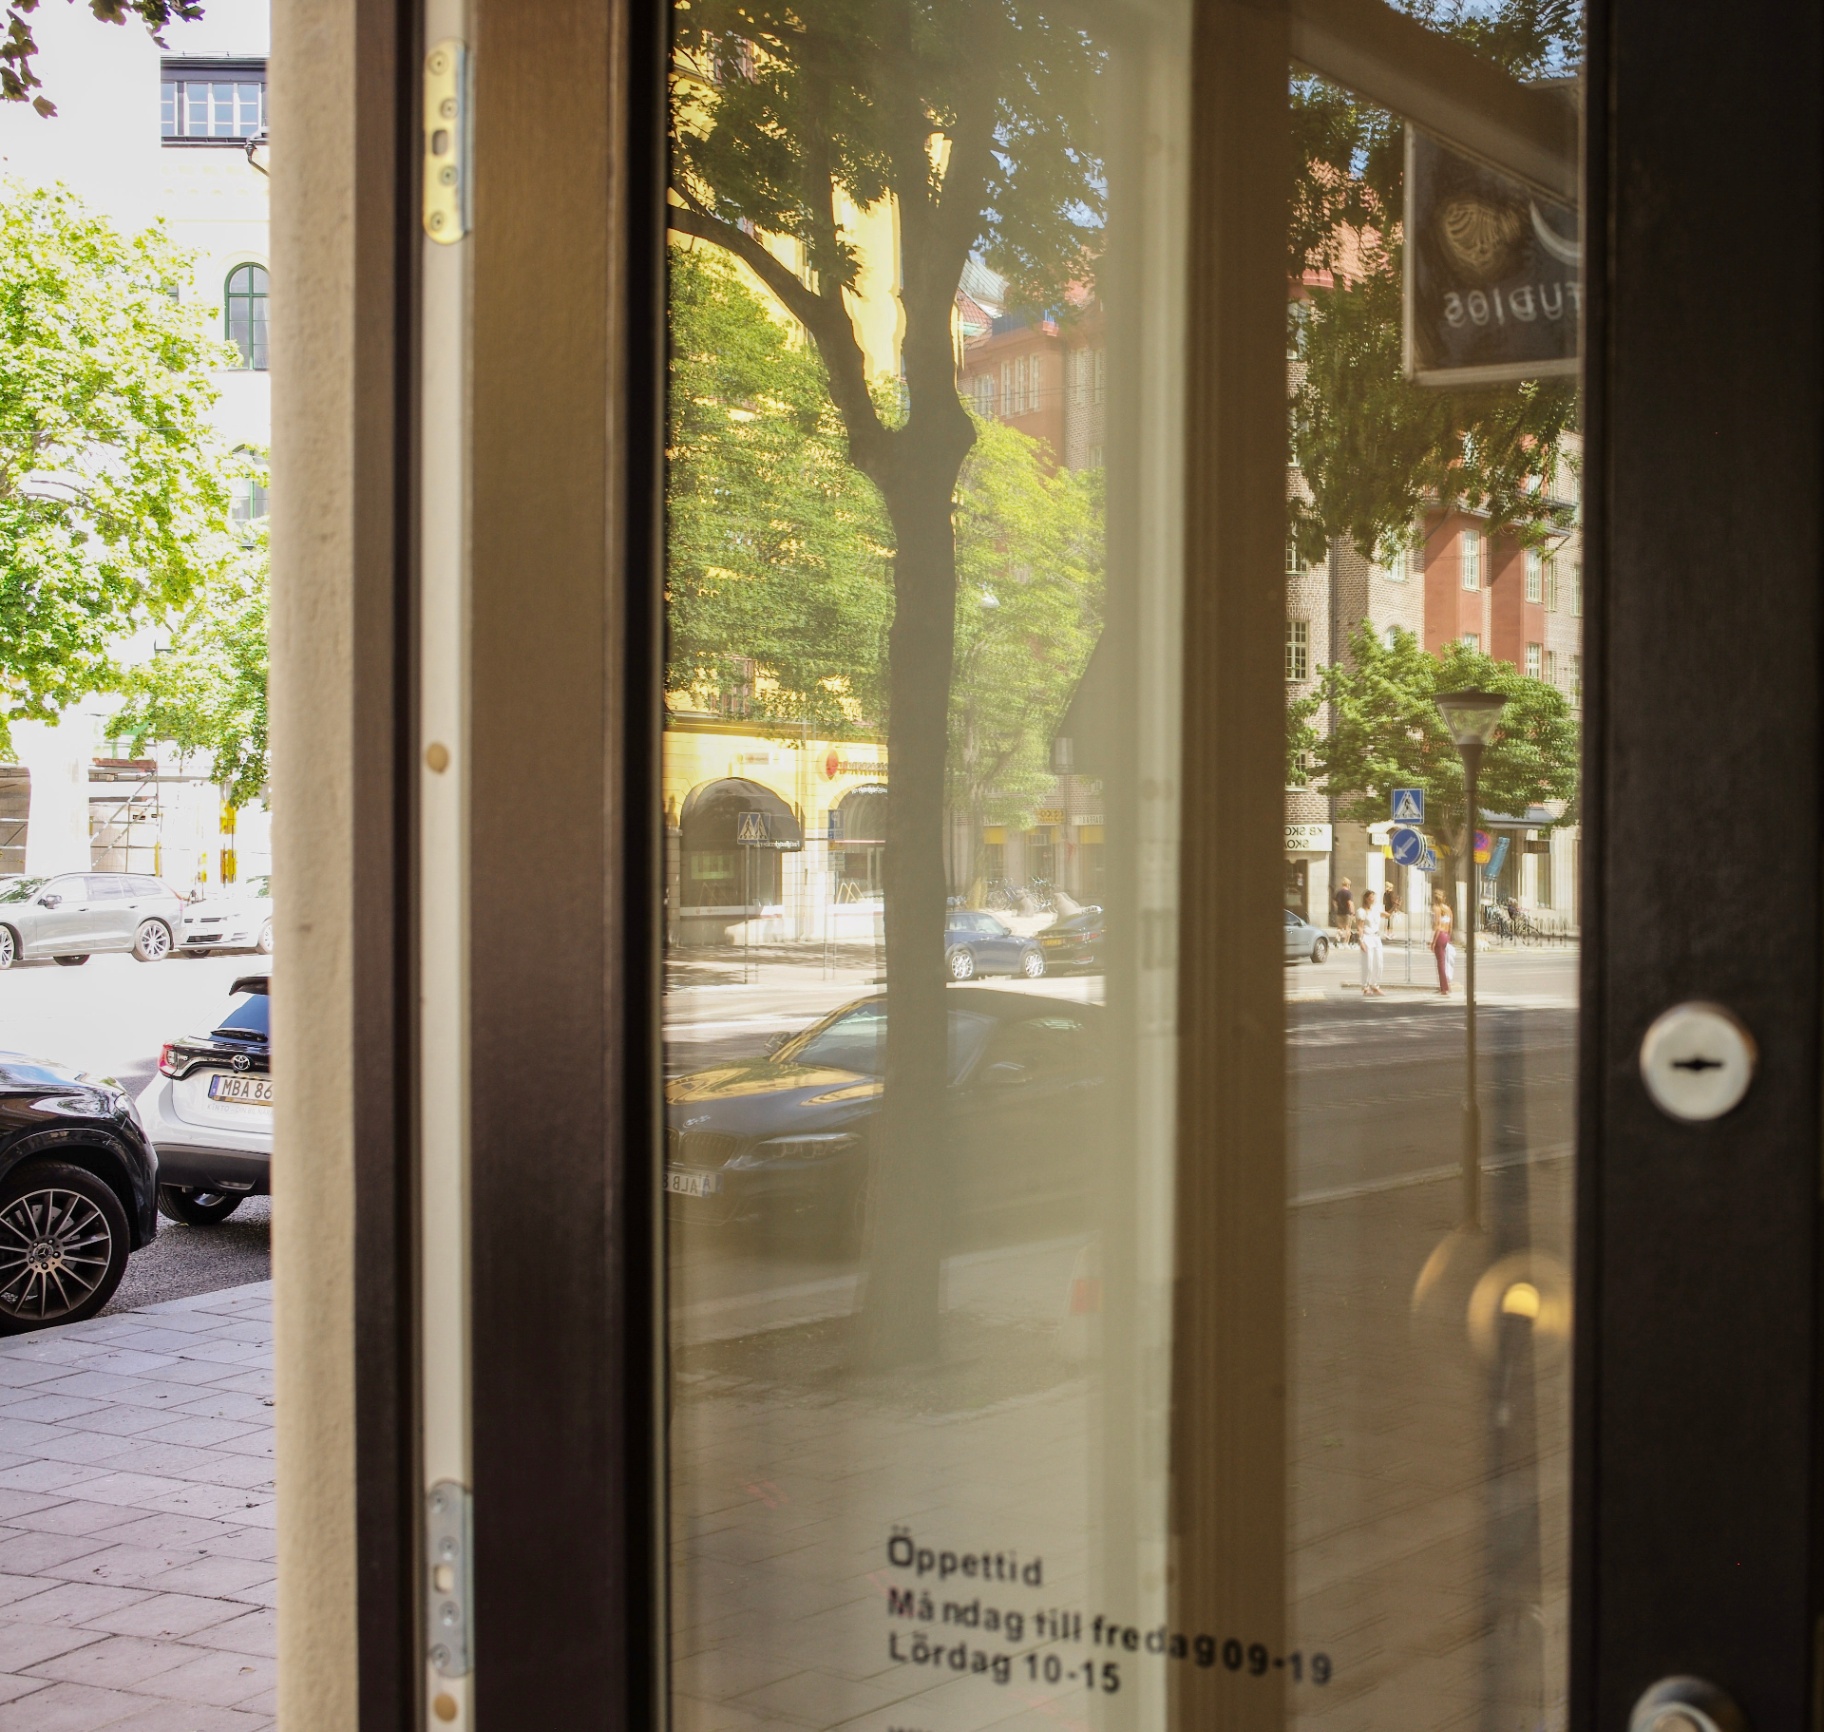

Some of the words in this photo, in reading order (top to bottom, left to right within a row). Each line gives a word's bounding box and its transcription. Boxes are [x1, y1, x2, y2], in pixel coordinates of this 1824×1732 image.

[221, 1079, 250, 1098] MBA
[887, 1525, 1044, 1588] Öppettid
[1034, 1609, 1082, 1642] till
[888, 1632, 1012, 1685] Lördag
[1025, 1652, 1122, 1694] 10-15
